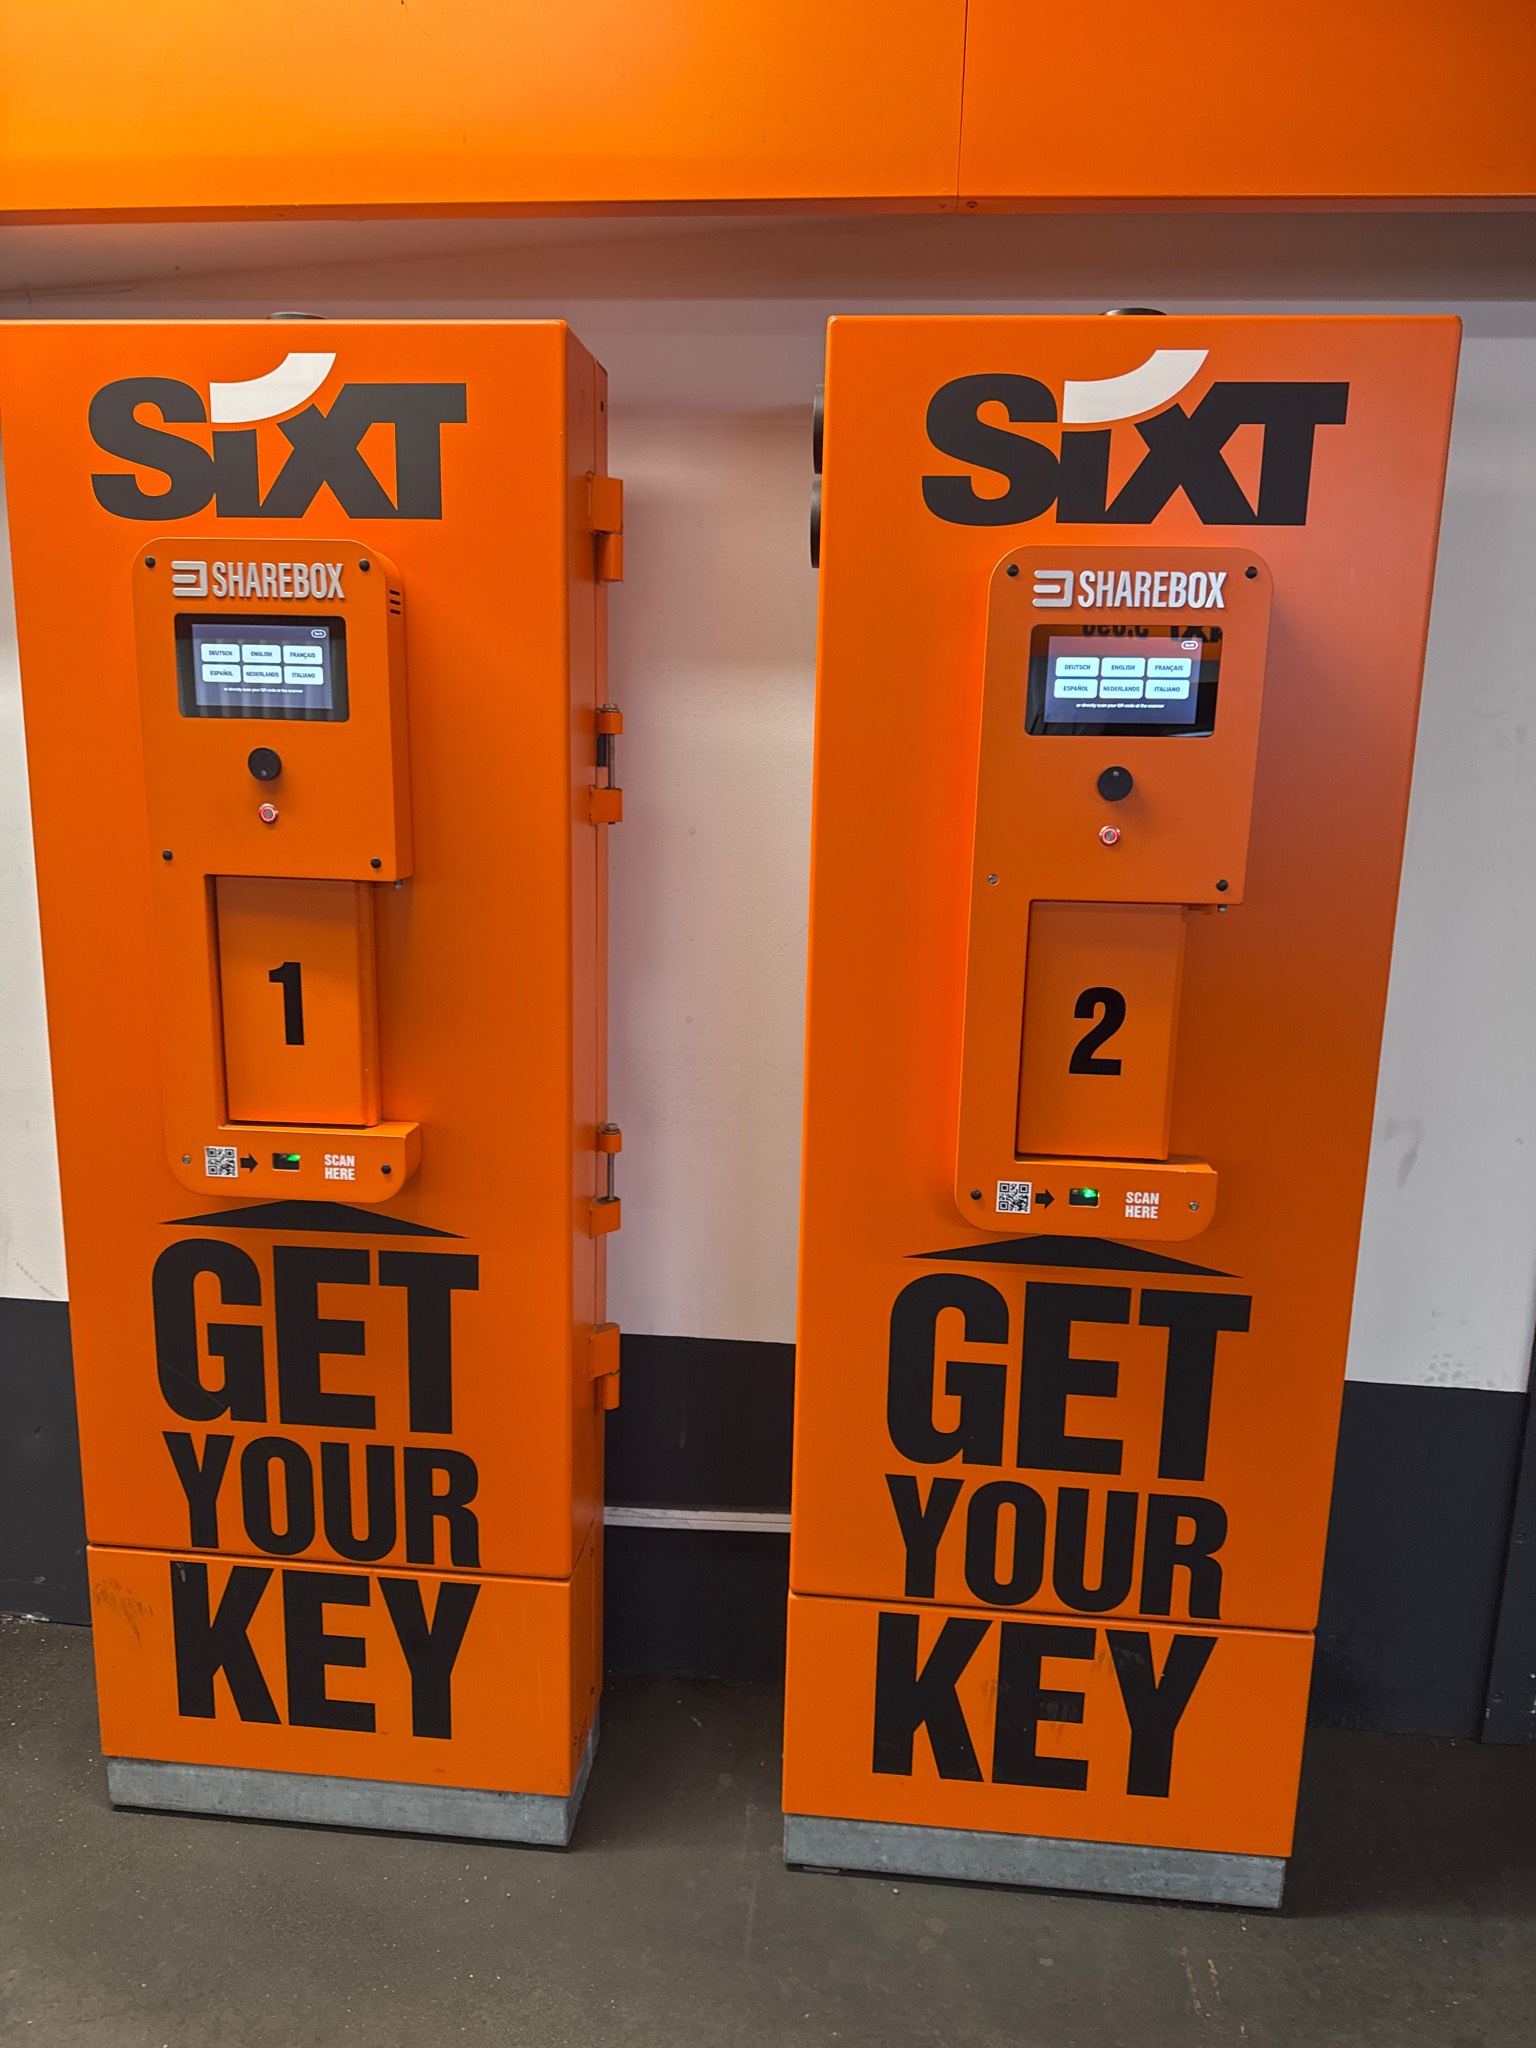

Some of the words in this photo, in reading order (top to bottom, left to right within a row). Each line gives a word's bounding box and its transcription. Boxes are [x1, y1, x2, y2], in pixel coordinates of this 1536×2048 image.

[211, 561, 346, 599] SHAREBOX
[1077, 570, 1227, 609] SHAREBOX
[1063, 684, 1089, 692] ESPAÑOL
[269, 961, 304, 1046] 1
[1069, 987, 1126, 1076] 2
[324, 1154, 355, 1167] SCAN
[324, 1167, 356, 1180] HERE
[1125, 1191, 1160, 1205] SCAN
[1125, 1205, 1159, 1219] HERE
[152, 1238, 480, 1435] GET
[886, 1272, 1253, 1482] GET
[162, 1431, 482, 1569] YOUR
[884, 1473, 1229, 1621] YOUR
[170, 1562, 482, 1740] KEY
[871, 1611, 1219, 1799] KEY
